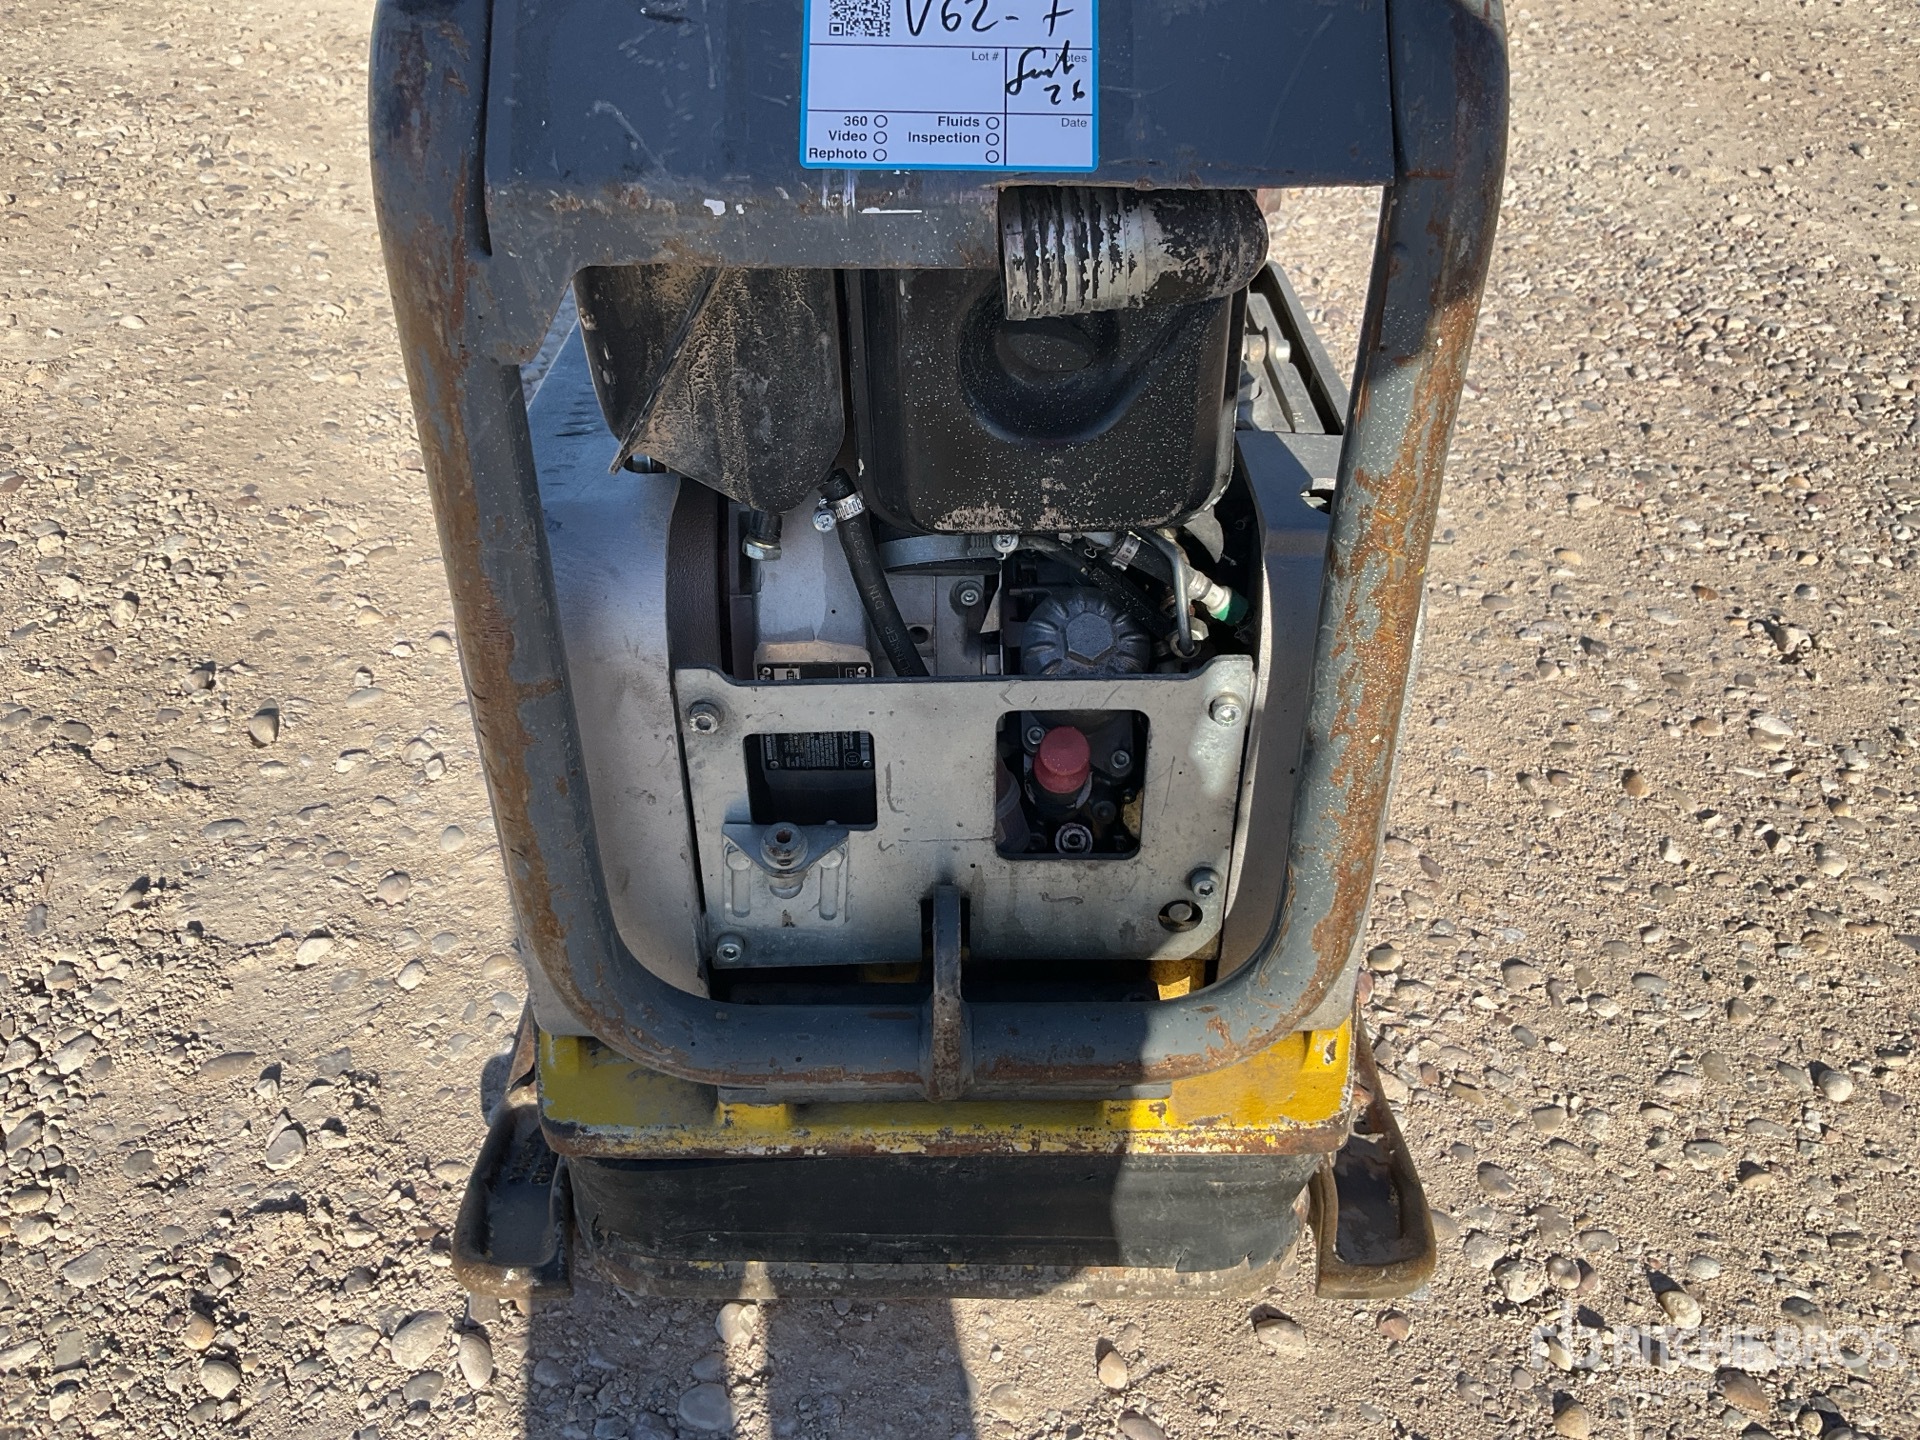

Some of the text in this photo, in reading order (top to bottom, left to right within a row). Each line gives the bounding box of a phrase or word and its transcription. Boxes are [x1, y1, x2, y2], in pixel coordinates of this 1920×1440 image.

[971, 52, 999, 62] Lot #
[1055, 53, 1088, 63] Notes
[843, 116, 868, 126] 360
[937, 116, 980, 128] Fluids
[1061, 117, 1088, 128] Date
[828, 131, 868, 142] Video
[908, 132, 980, 145] Inspection
[808, 148, 868, 161] Rephoto
[868, 583, 886, 610] DIN
